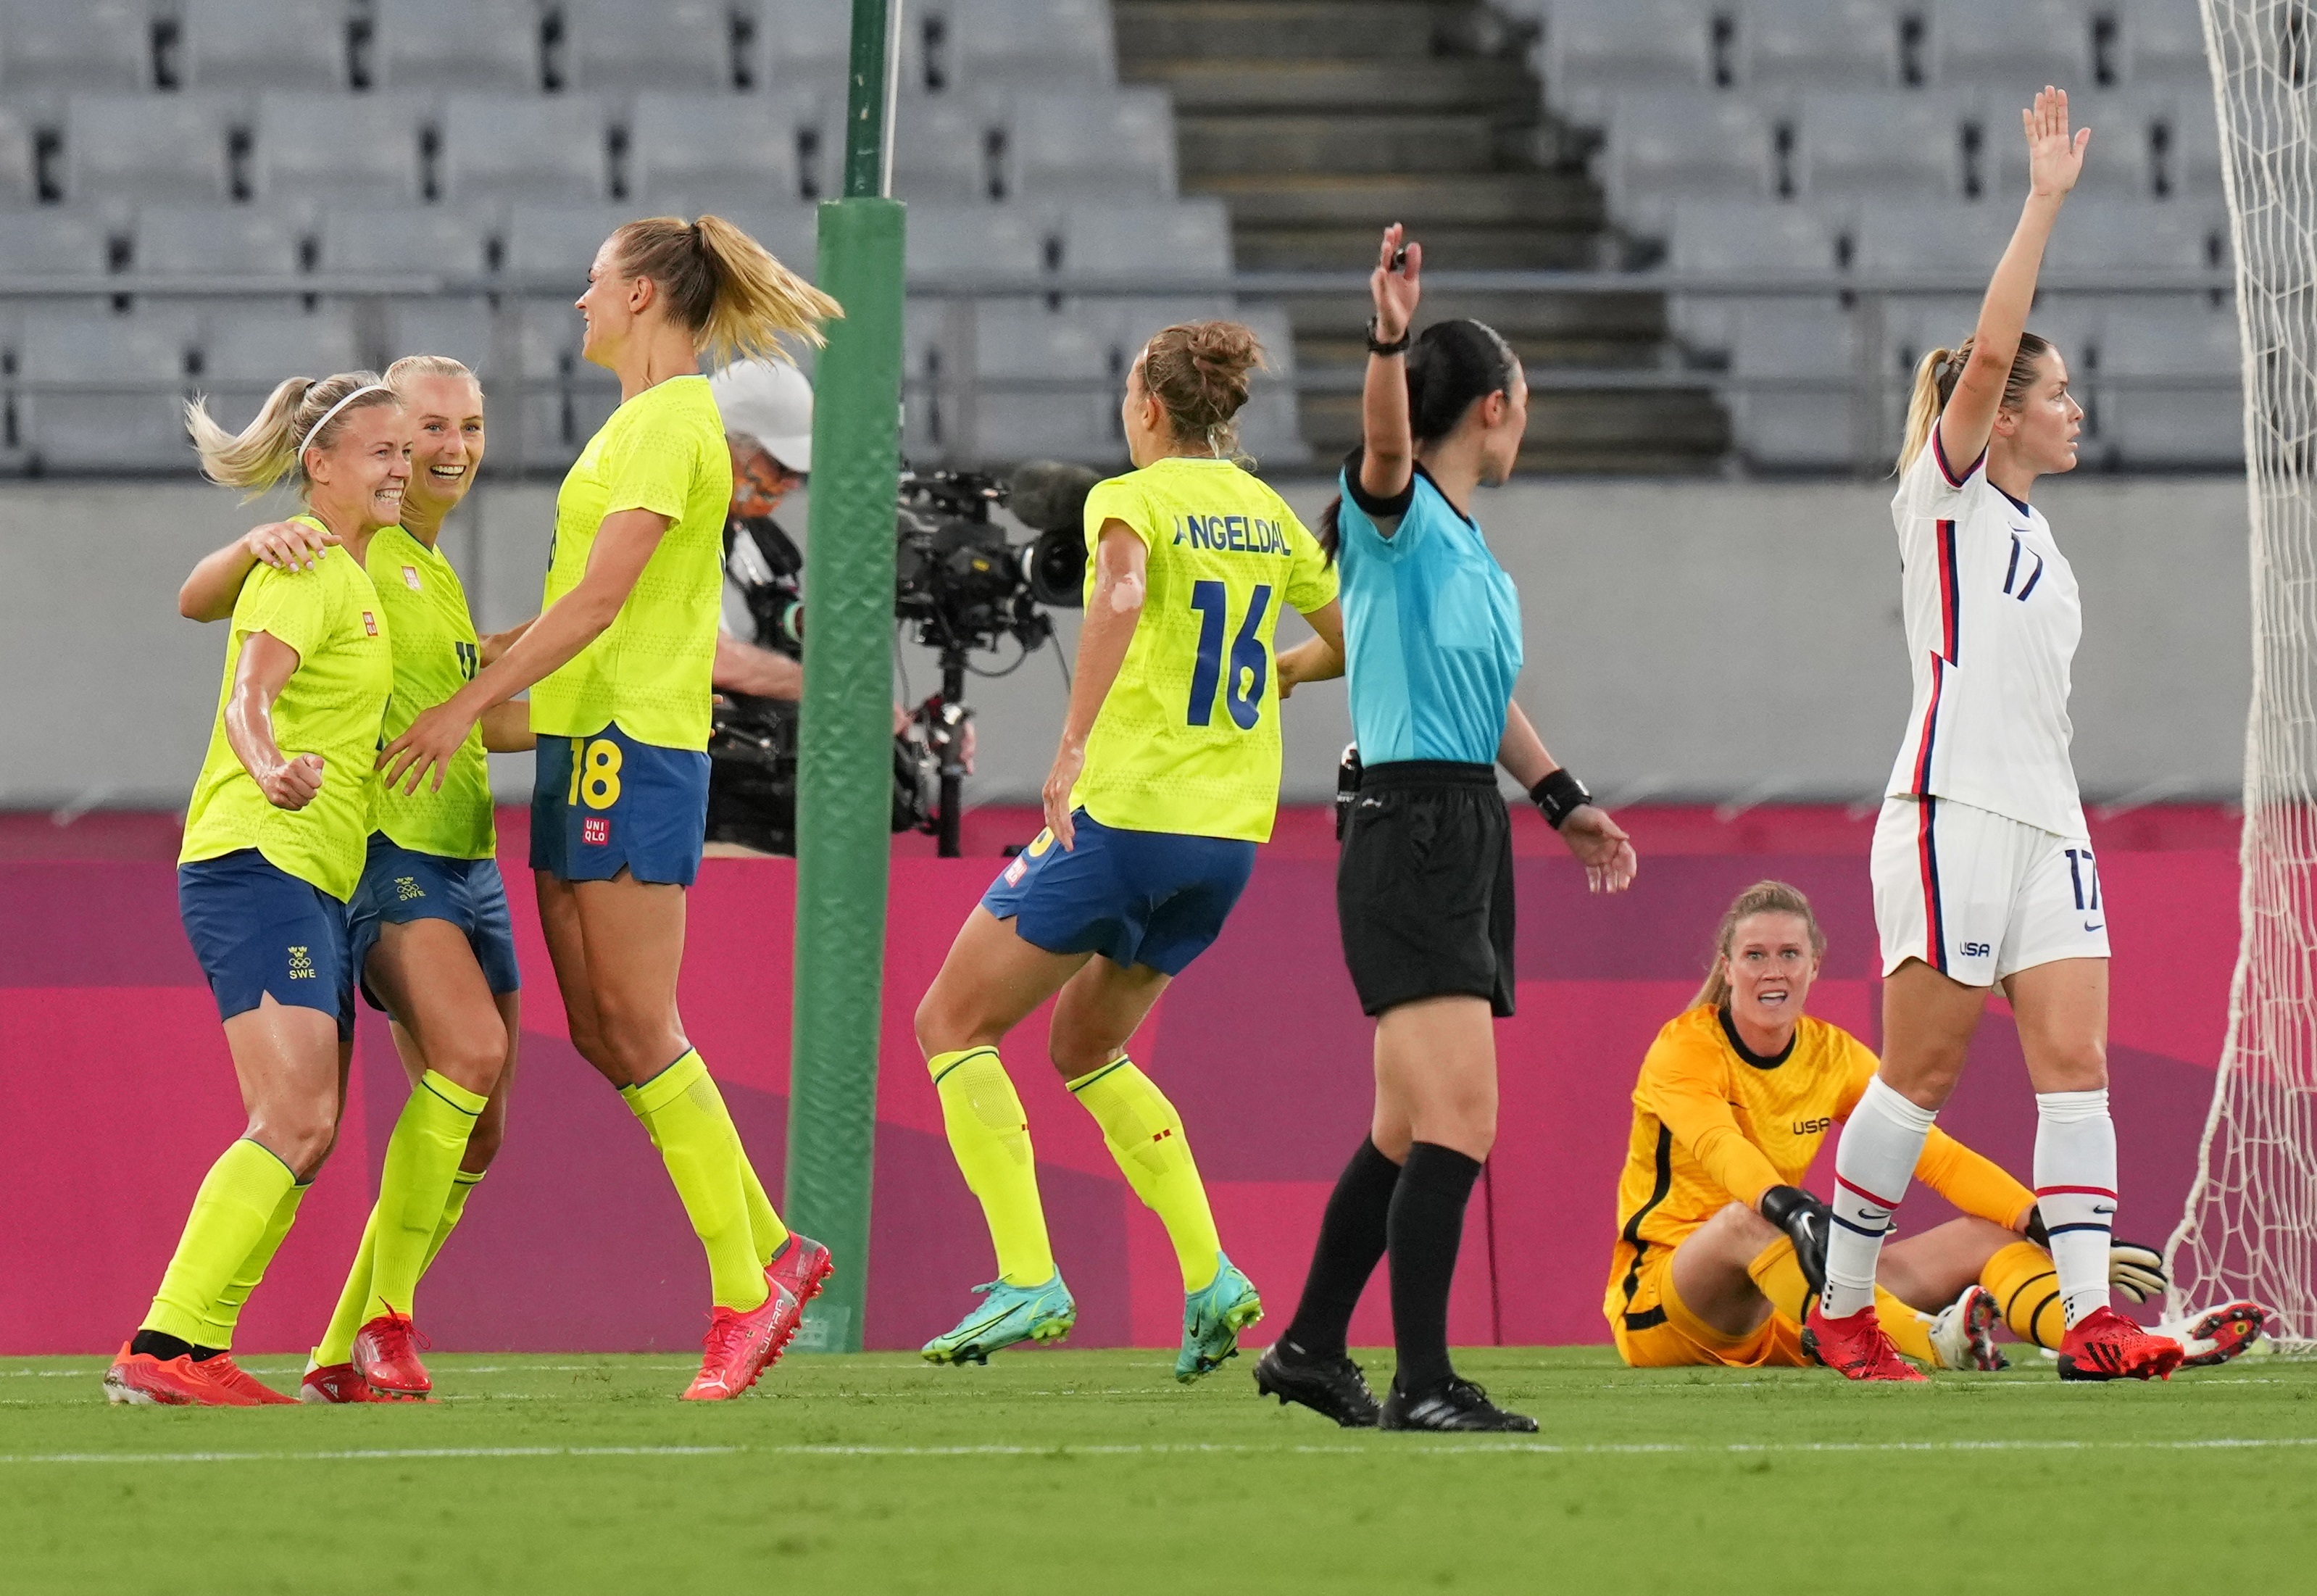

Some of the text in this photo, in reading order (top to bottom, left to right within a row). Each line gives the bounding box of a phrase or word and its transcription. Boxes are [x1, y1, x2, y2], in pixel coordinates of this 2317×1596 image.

[2003, 532, 2043, 602] 17
[1187, 581, 1271, 730] 16
[568, 738, 622, 810] 18
[586, 820, 604, 831] UNI
[585, 831, 604, 841] QLO
[2065, 849, 2097, 910] 17
[399, 890, 425, 901] SWE
[1960, 942, 1990, 957] USA
[289, 969, 316, 979] SWE
[1793, 1117, 1831, 1135] USA
[760, 1299, 784, 1354] ULTRA
